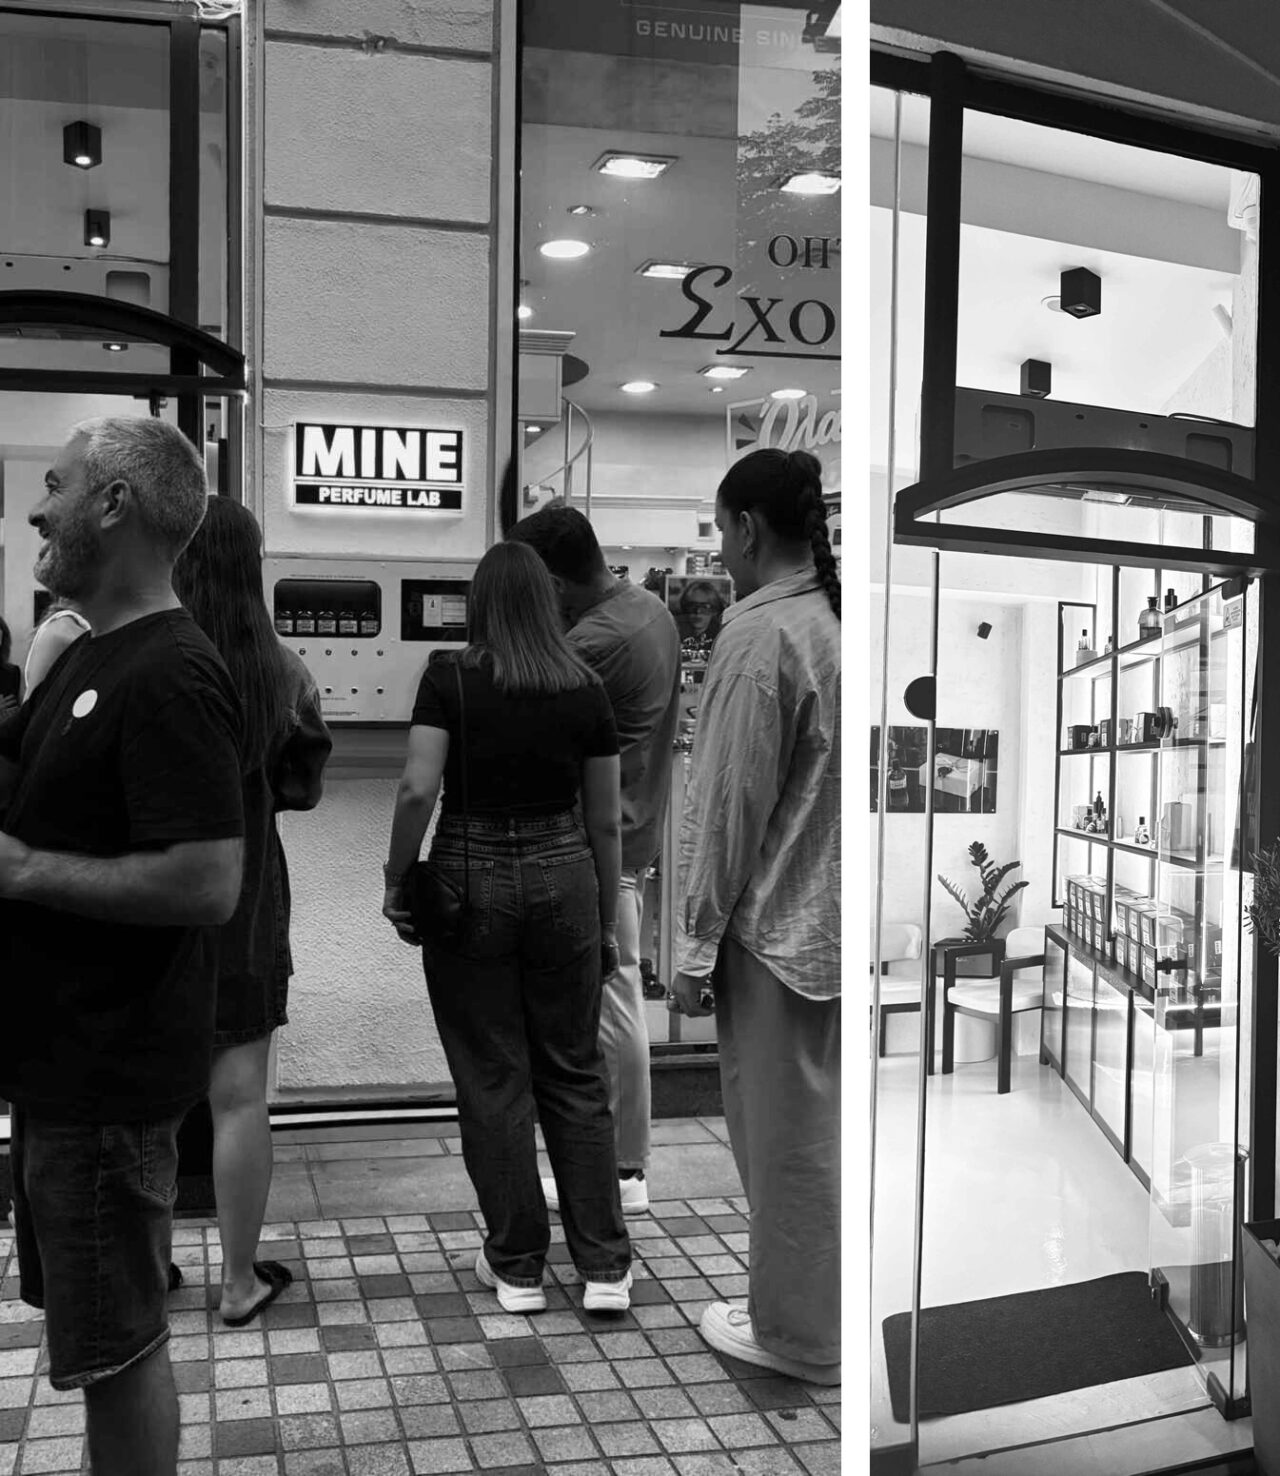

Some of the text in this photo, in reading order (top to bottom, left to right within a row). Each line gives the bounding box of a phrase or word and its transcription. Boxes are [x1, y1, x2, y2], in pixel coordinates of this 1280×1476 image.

[636, 19, 744, 44] GENUINE
[767, 234, 841, 269] ΟΠ
[302, 426, 458, 482] MINE
[319, 486, 441, 506] PERFUME LAB
